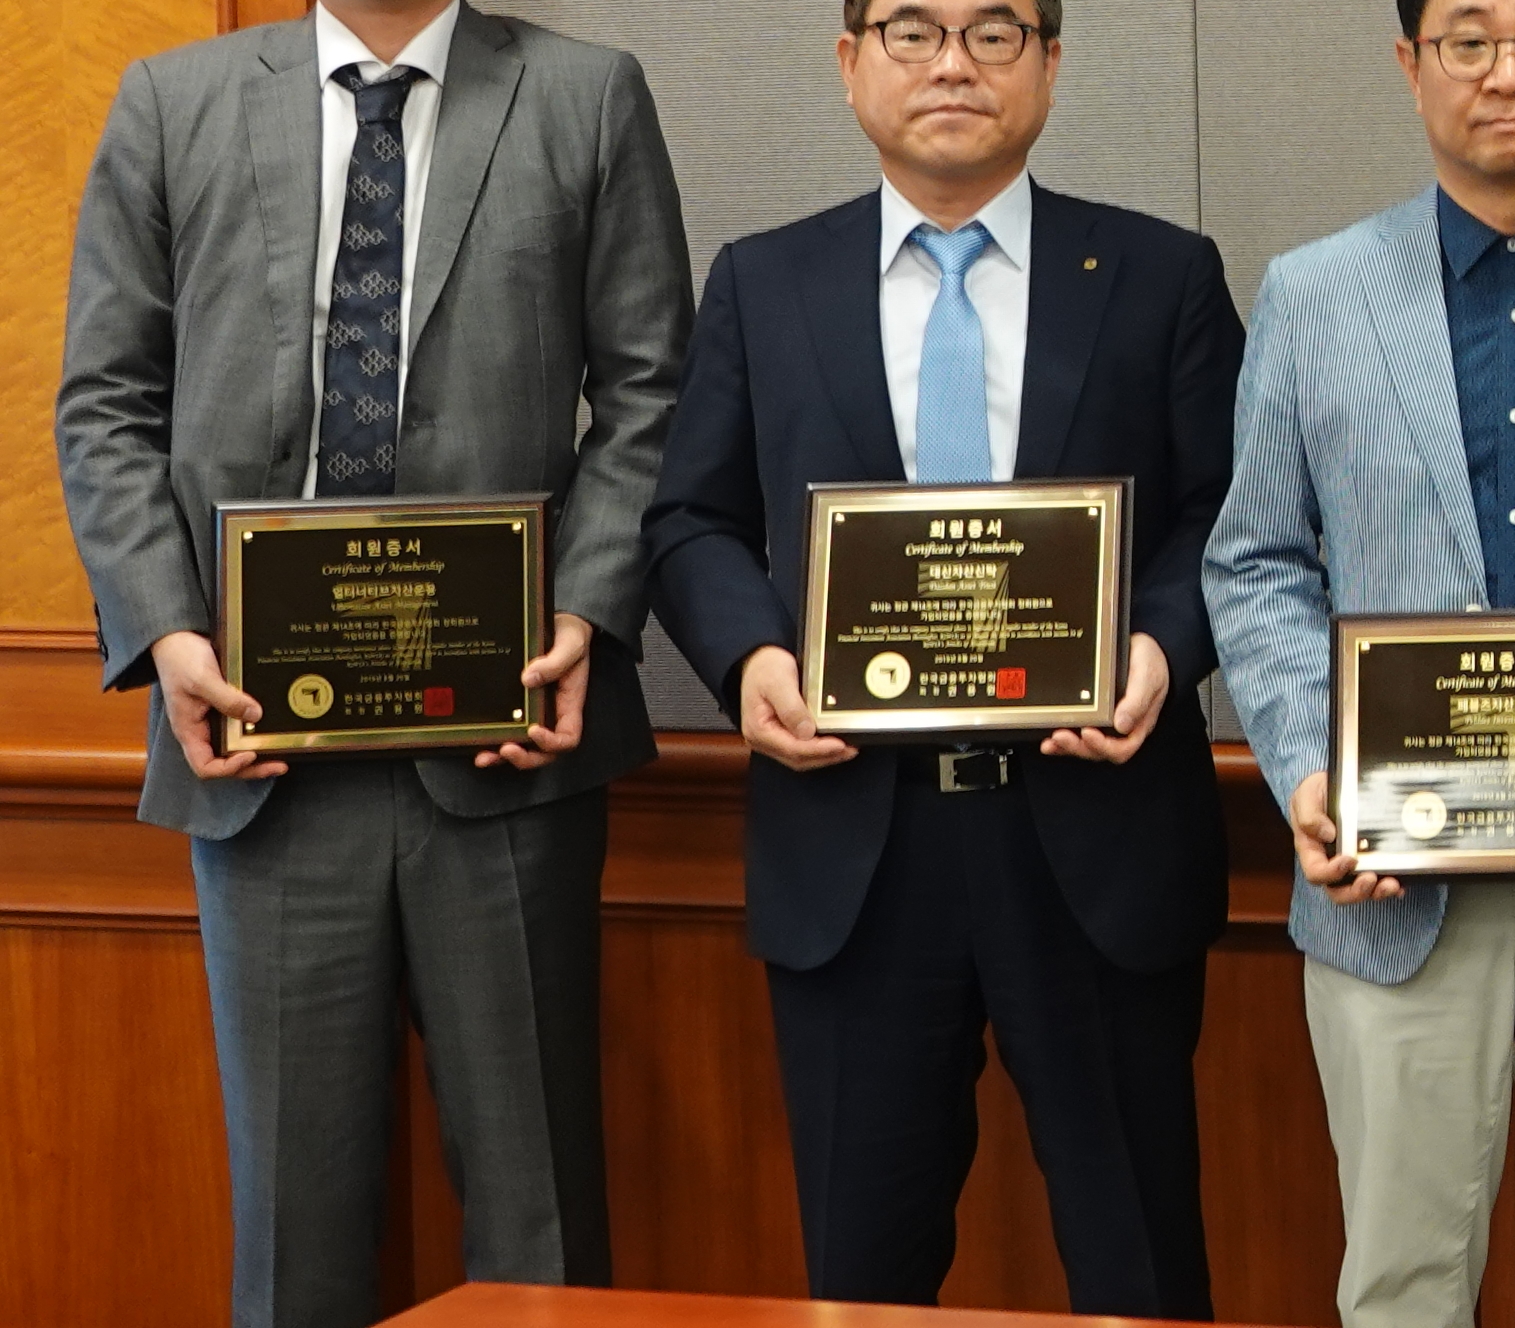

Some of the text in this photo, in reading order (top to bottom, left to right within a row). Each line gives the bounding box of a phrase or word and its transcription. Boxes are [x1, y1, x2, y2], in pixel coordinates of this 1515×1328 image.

[905, 539, 1024, 557] Certificate of Membership
[322, 562, 371, 578] Certificate
[388, 559, 445, 574] Membership
[1436, 675, 1485, 692] Certificate
[1487, 674, 1500, 691] of
